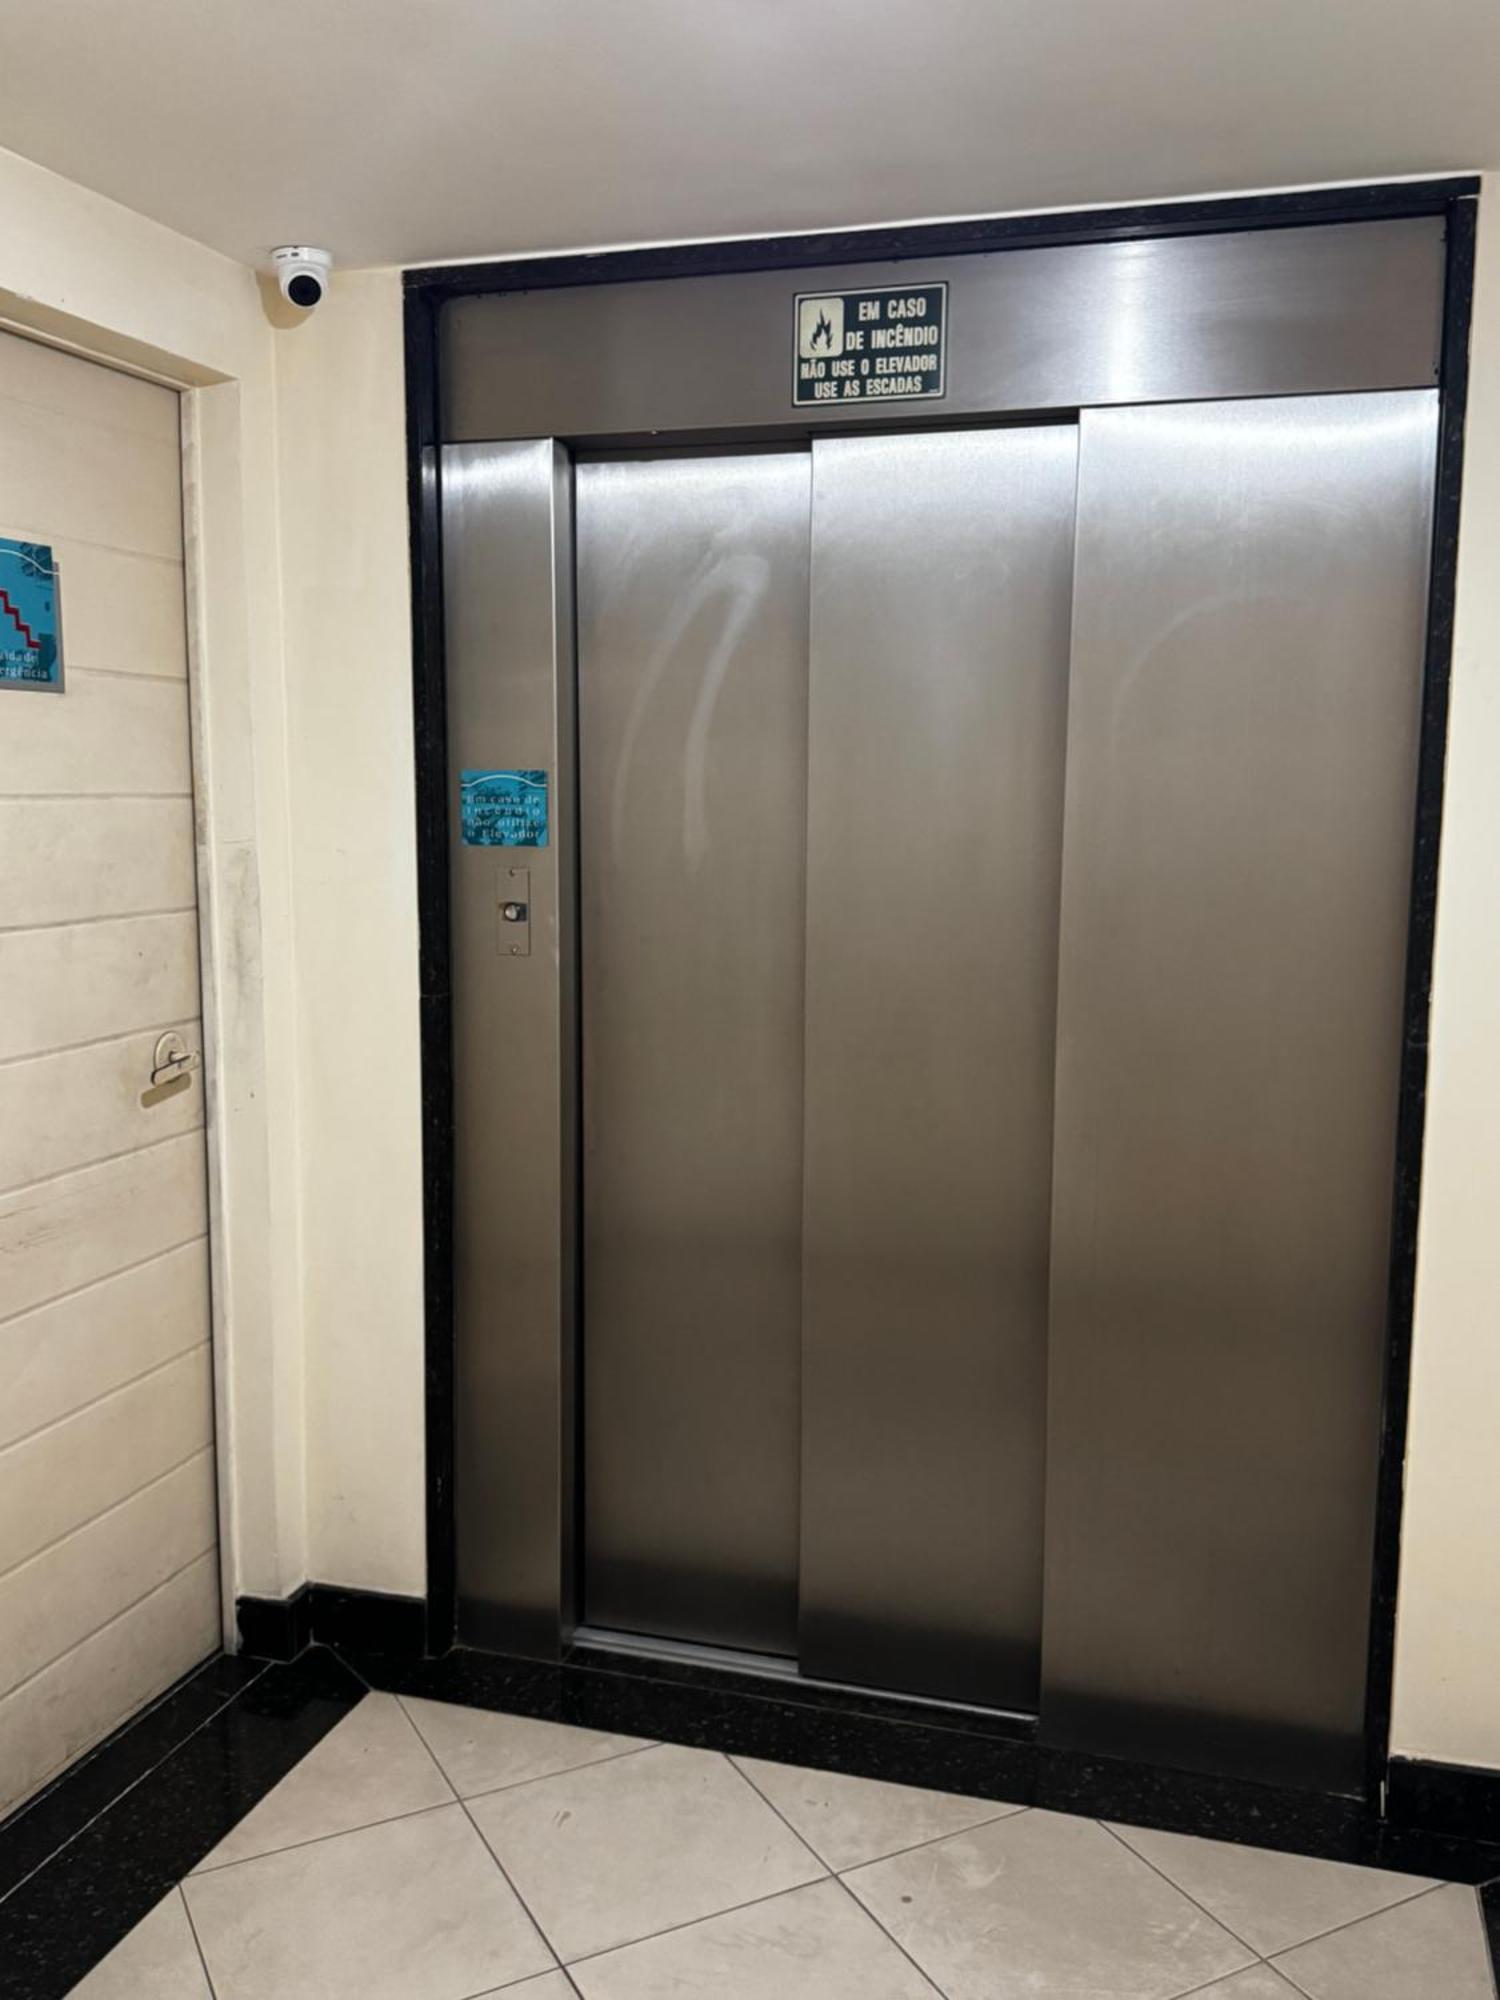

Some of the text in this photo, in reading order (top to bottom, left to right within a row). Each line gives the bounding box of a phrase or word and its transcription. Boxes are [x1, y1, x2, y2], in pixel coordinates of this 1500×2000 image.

[858, 297, 926, 321] EM CASO
[845, 323, 938, 351] DE INCÊNDIO
[800, 354, 937, 379] NÃO USE O ELEVADOR
[814, 375, 922, 398] USE AS ESCADAS
[490, 796, 520, 804] caso
[524, 794, 540, 804] de
